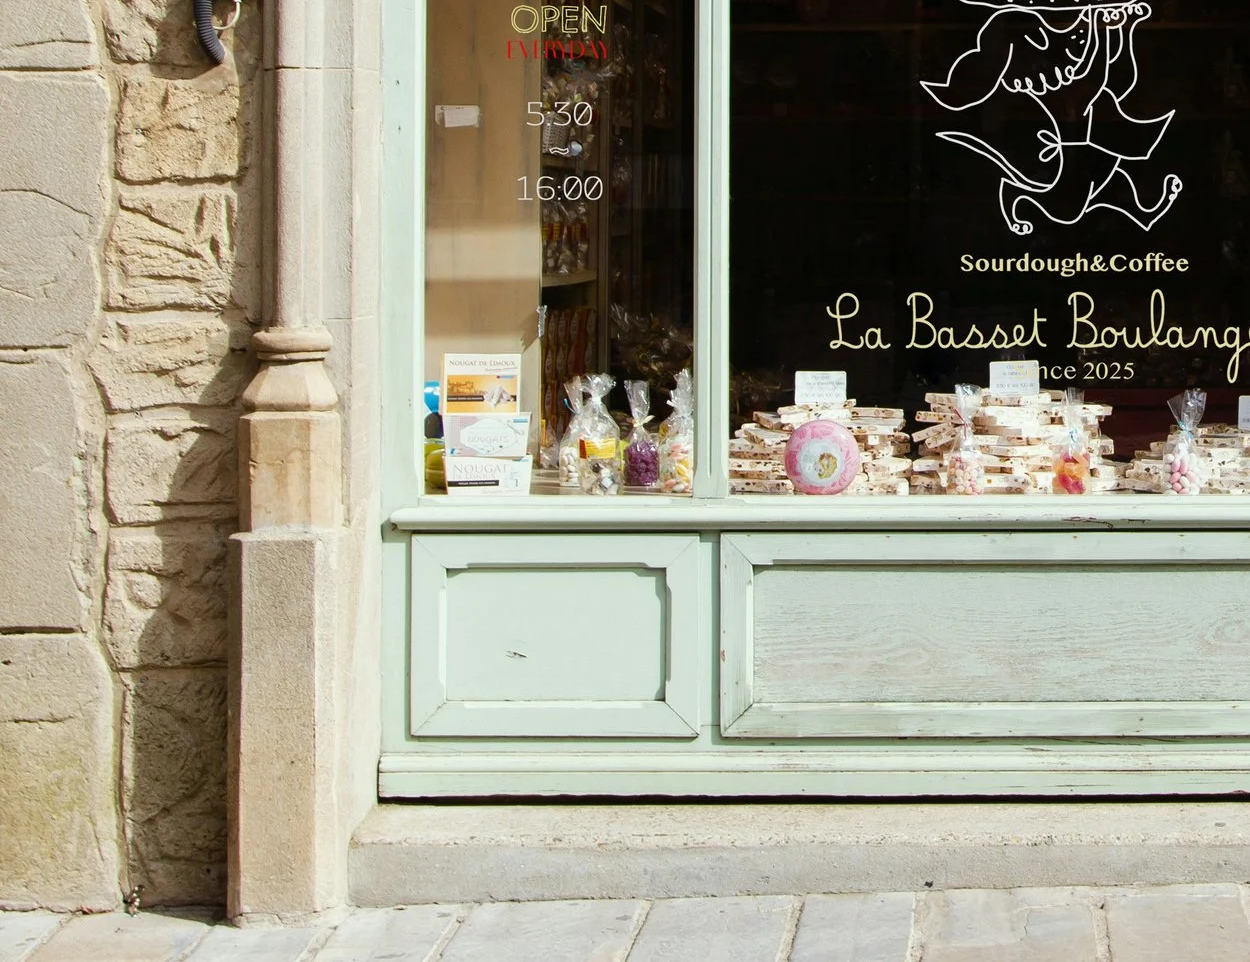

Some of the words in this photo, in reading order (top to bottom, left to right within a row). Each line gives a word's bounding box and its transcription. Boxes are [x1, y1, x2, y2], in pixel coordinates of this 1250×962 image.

[511, 5, 608, 34] OPEN
[507, 39, 611, 59] EVERYDAY
[525, 101, 594, 127] 5:30
[517, 175, 604, 201] 16:00
[960, 251, 1190, 277] Sourdough&Coffee
[826, 292, 891, 350] La
[906, 291, 1048, 350] Basset
[1083, 362, 1135, 380] 2025
